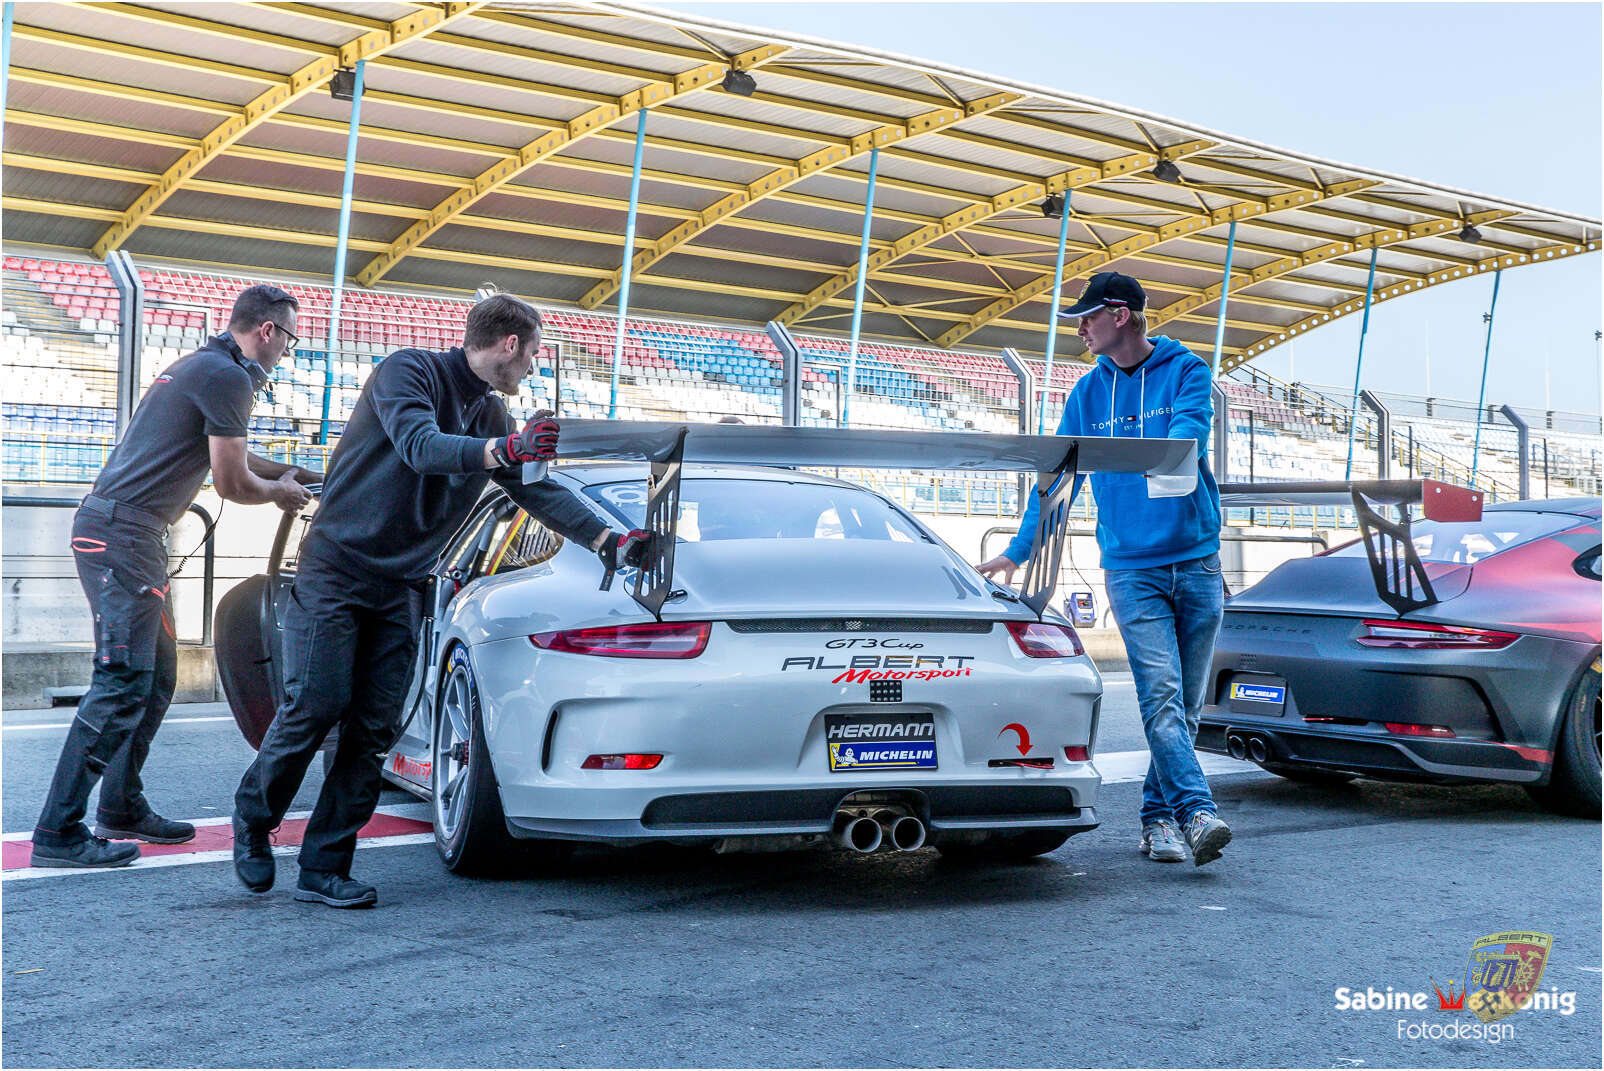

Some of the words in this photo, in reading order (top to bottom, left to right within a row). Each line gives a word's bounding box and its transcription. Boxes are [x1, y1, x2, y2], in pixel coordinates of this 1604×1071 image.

[781, 654, 975, 671] ALBERT
[831, 666, 974, 685] Motorsport
[827, 722, 934, 740] HERMANN
[859, 749, 934, 762] MICHELIN
